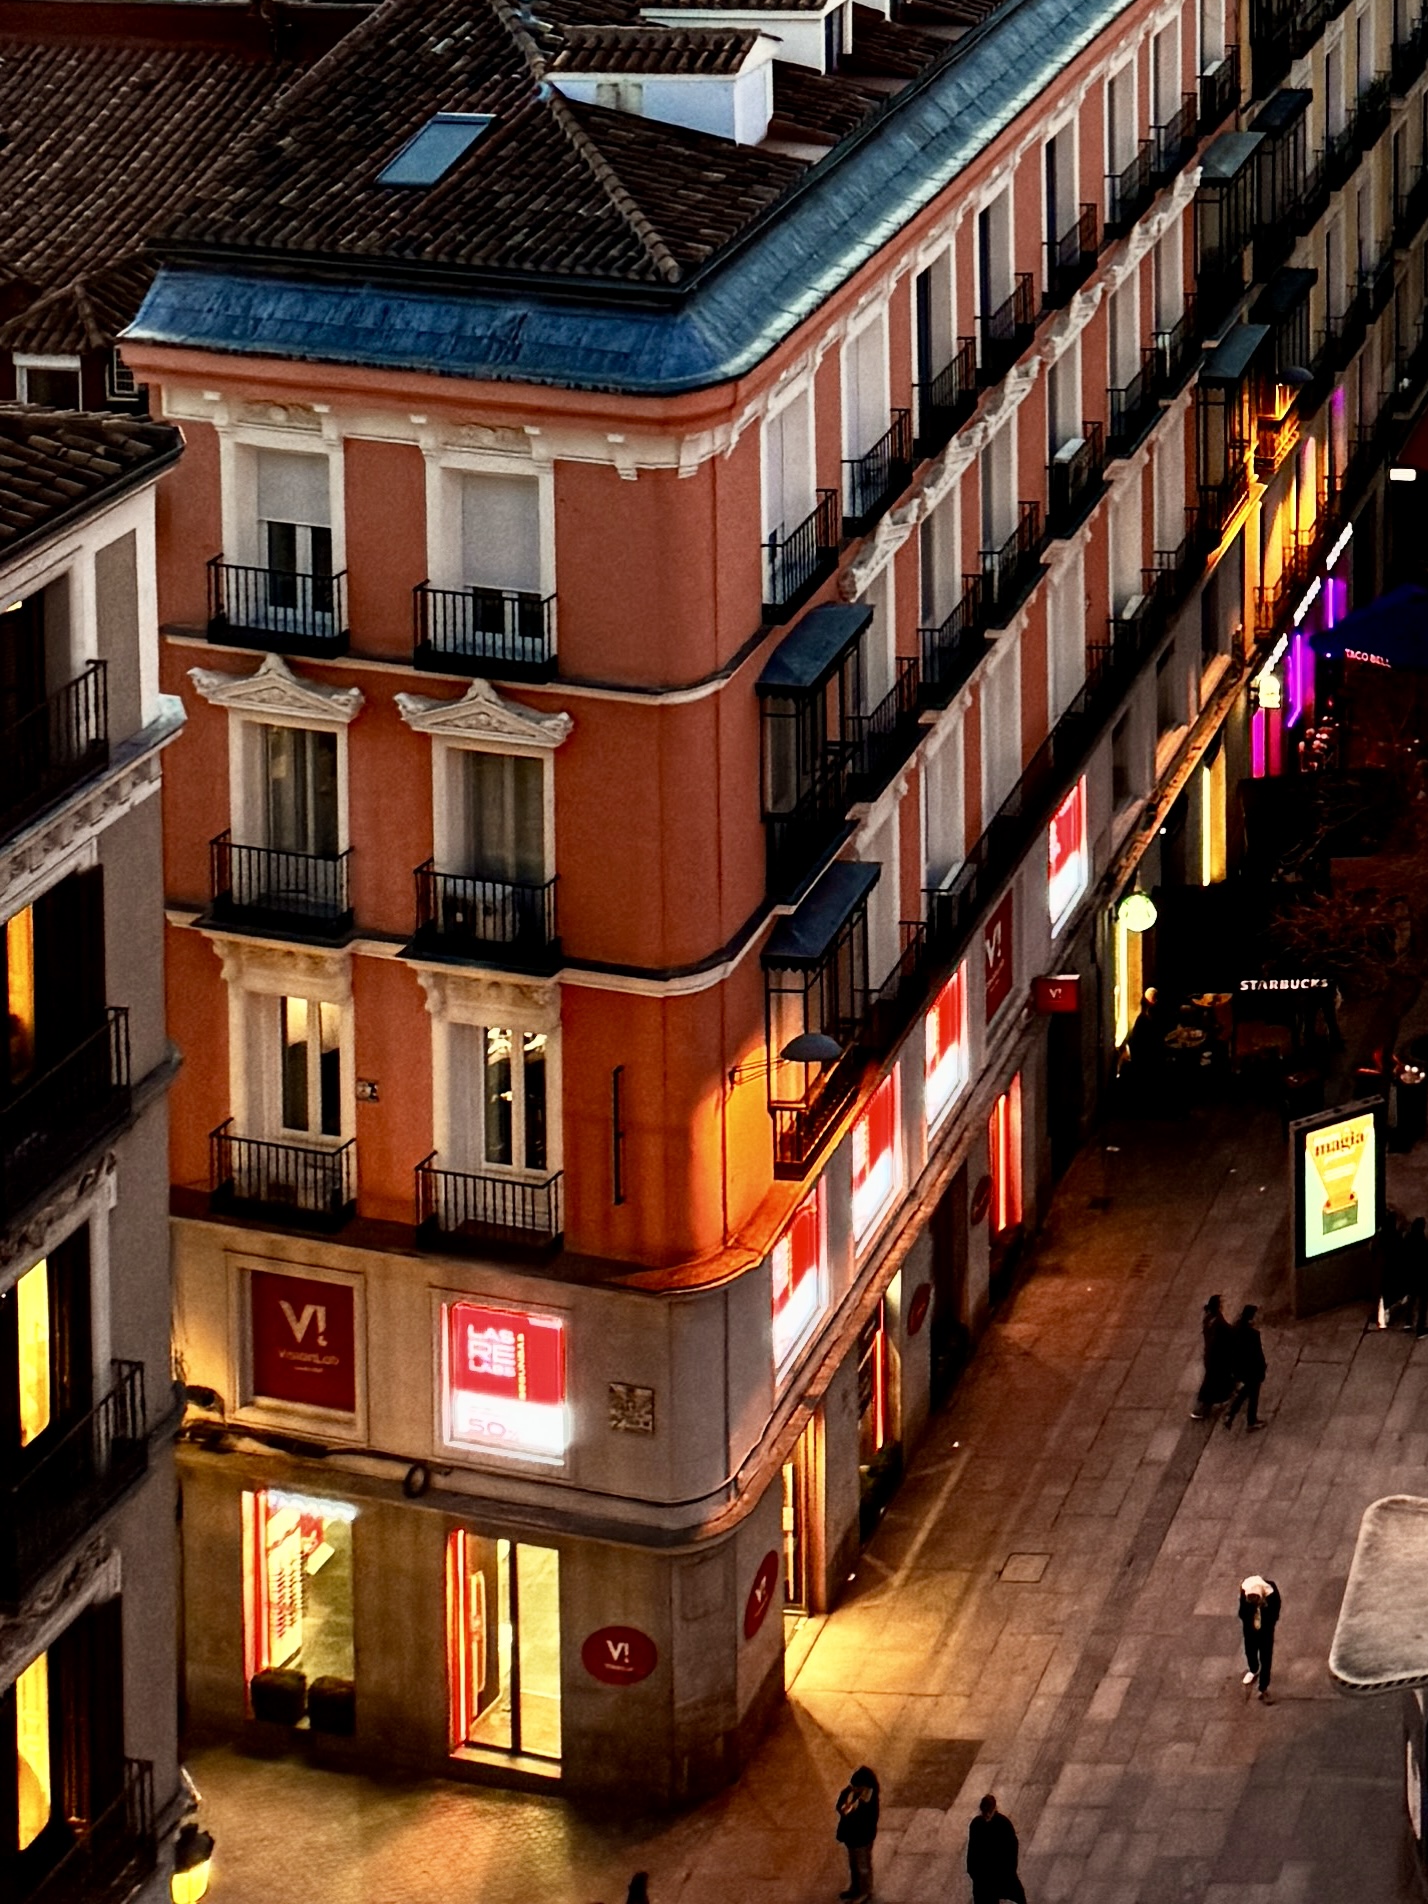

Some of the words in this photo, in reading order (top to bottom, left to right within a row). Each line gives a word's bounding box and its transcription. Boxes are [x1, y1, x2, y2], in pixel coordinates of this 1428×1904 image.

[1345, 648, 1369, 662] TACO
[1240, 978, 1329, 991] STARBUCKS
[1315, 1130, 1365, 1157] magia
